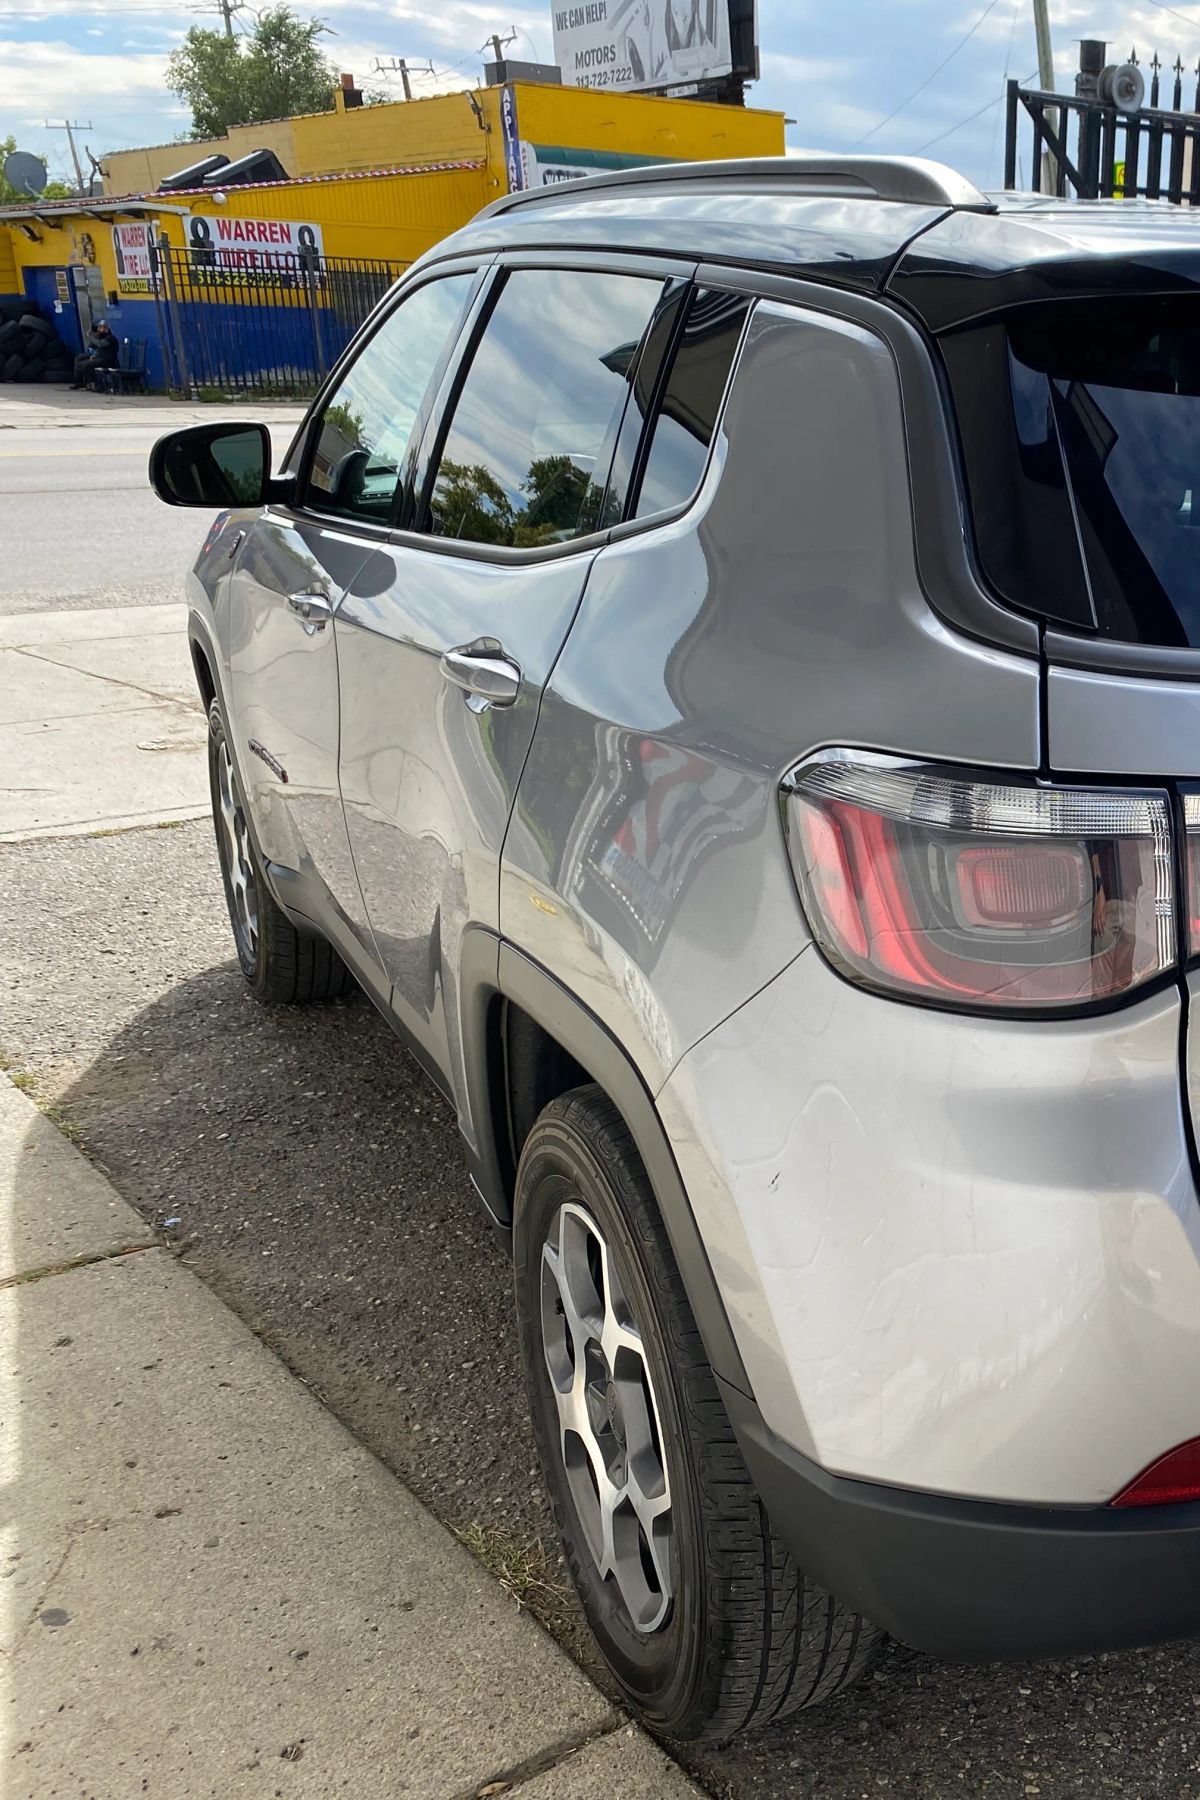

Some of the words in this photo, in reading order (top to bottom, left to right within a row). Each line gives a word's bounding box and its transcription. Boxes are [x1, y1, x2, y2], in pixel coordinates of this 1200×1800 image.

[555, 13, 569, 31] WE
[569, 8, 585, 28] CAN
[585, 2, 607, 25] HELP!
[575, 44, 616, 70] MOTORS
[575, 67, 632, 89] 313-722-7222
[120, 227, 146, 247] WARREN
[216, 219, 292, 244] WARREN
[124, 255, 139, 275] TIRE
[219, 247, 259, 269] TIRE
